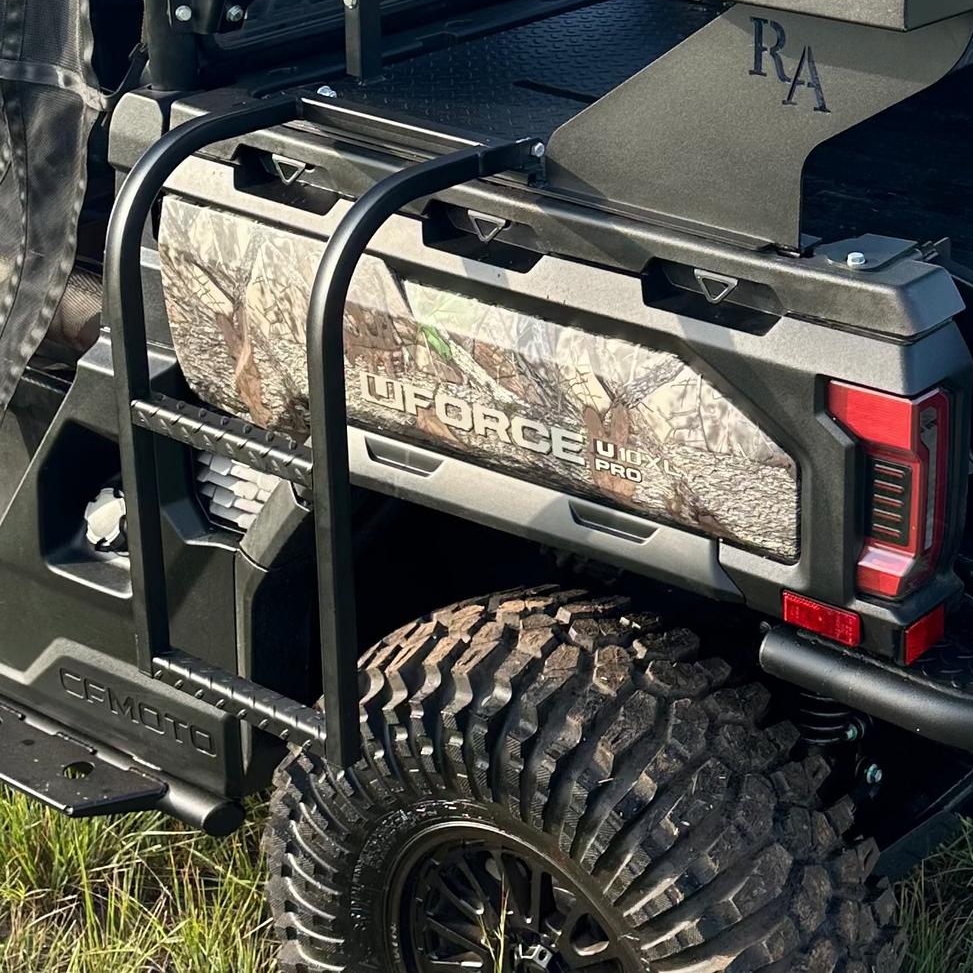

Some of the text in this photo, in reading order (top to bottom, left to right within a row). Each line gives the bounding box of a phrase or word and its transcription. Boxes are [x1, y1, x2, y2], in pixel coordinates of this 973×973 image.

[749, 15, 831, 114] RA
[361, 372, 585, 466] UFORCE
[595, 458, 641, 483] PRO
[60, 668, 217, 758] CFMOTO
